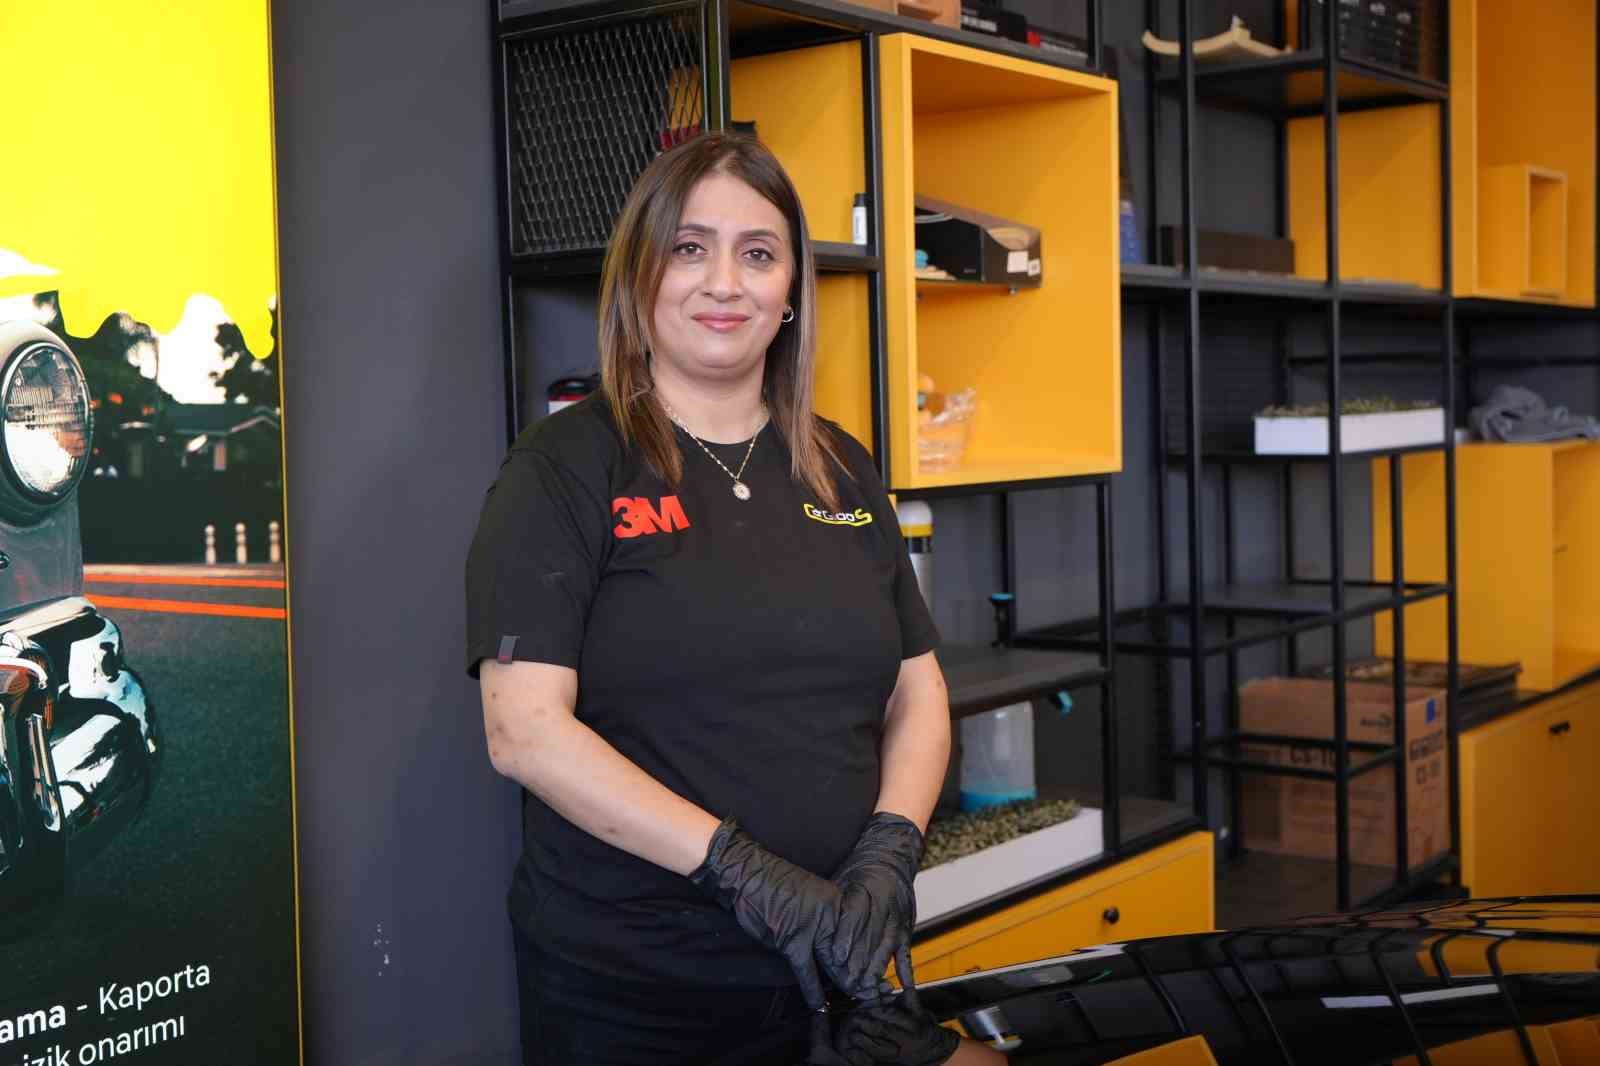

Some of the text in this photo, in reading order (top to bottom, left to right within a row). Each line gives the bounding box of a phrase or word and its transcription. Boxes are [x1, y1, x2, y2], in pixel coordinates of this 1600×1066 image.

[612, 495, 691, 538] 3M
[0, 1004, 67, 1043] ama
[99, 964, 211, 1015] Kaporta
[79, 1015, 185, 1066] onarımı
